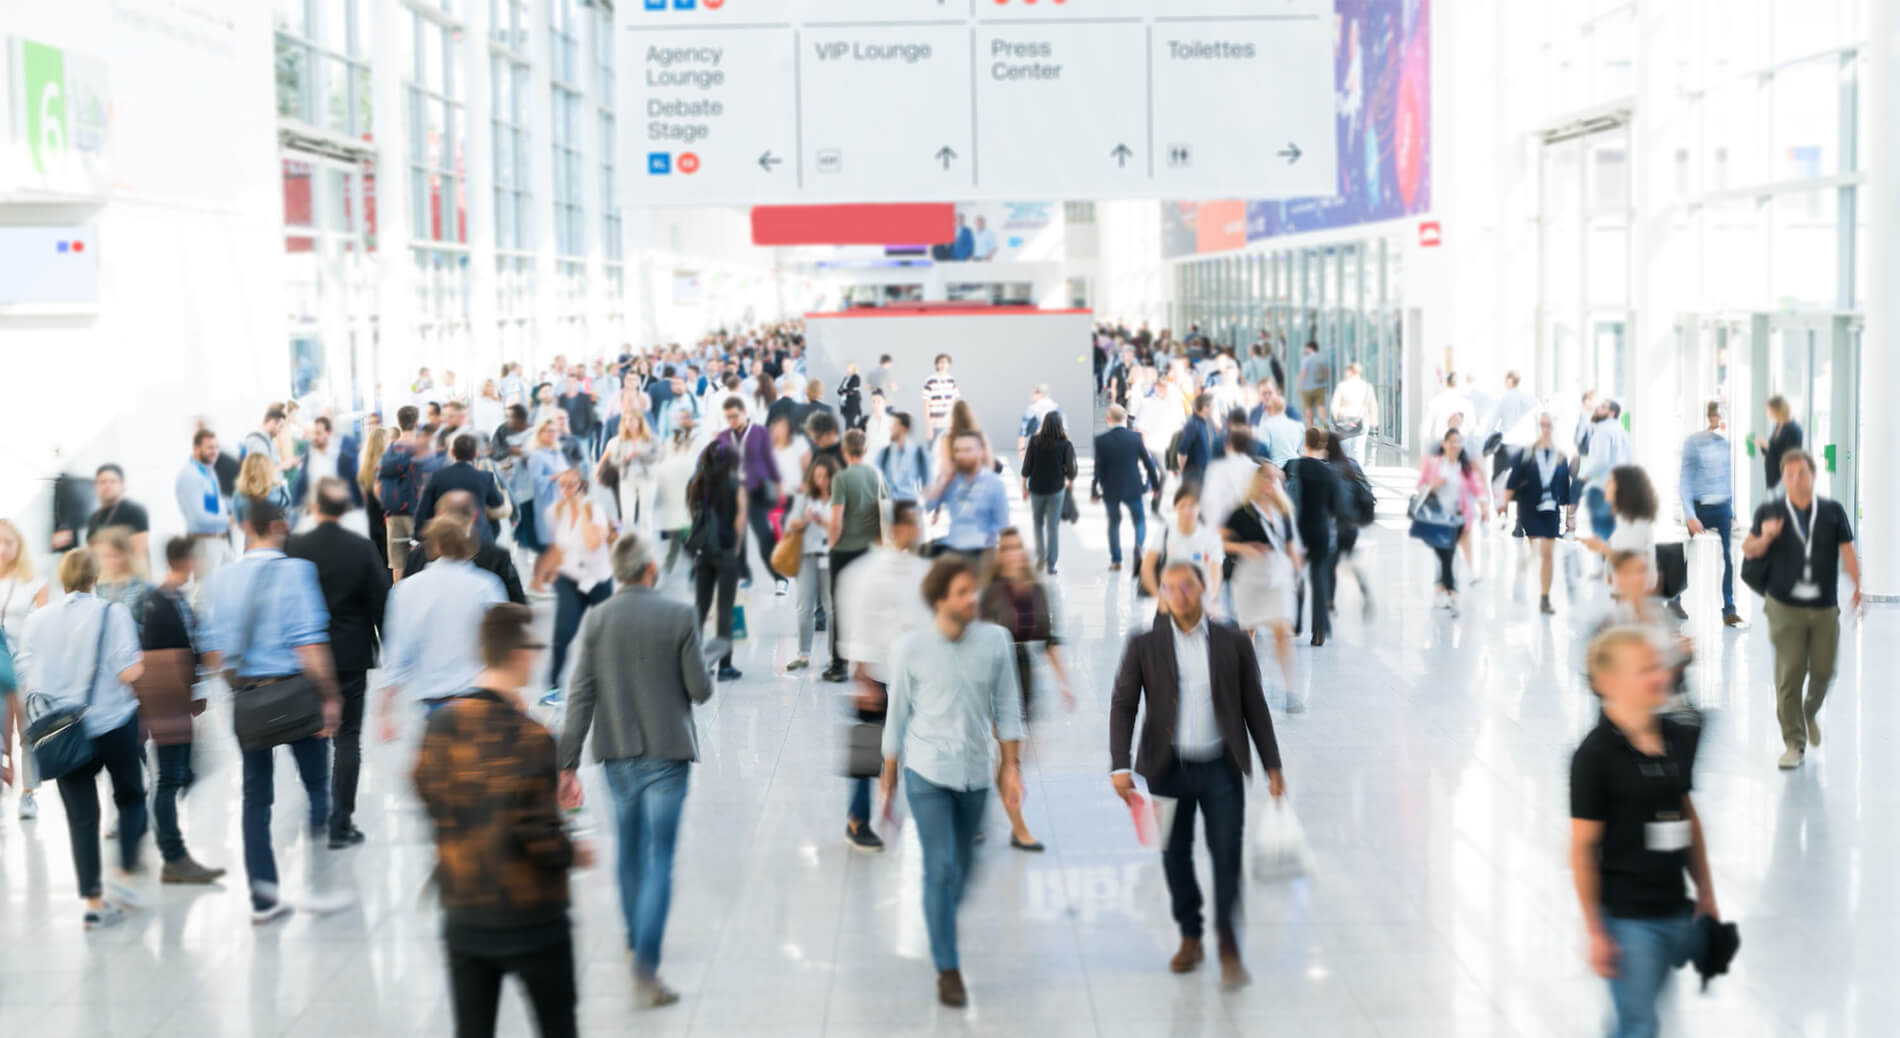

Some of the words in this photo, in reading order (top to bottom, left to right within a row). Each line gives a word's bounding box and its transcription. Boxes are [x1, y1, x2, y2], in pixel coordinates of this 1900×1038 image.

[646, 45, 723, 66] Agency
[815, 41, 849, 61] VIP
[853, 42, 932, 64] Lounge
[991, 39, 1052, 58] Press
[1168, 40, 1256, 59] Toilettes
[646, 67, 724, 89] Lounge
[991, 62, 1063, 81] Center
[647, 98, 723, 118] Debate
[648, 120, 709, 142] Stage
